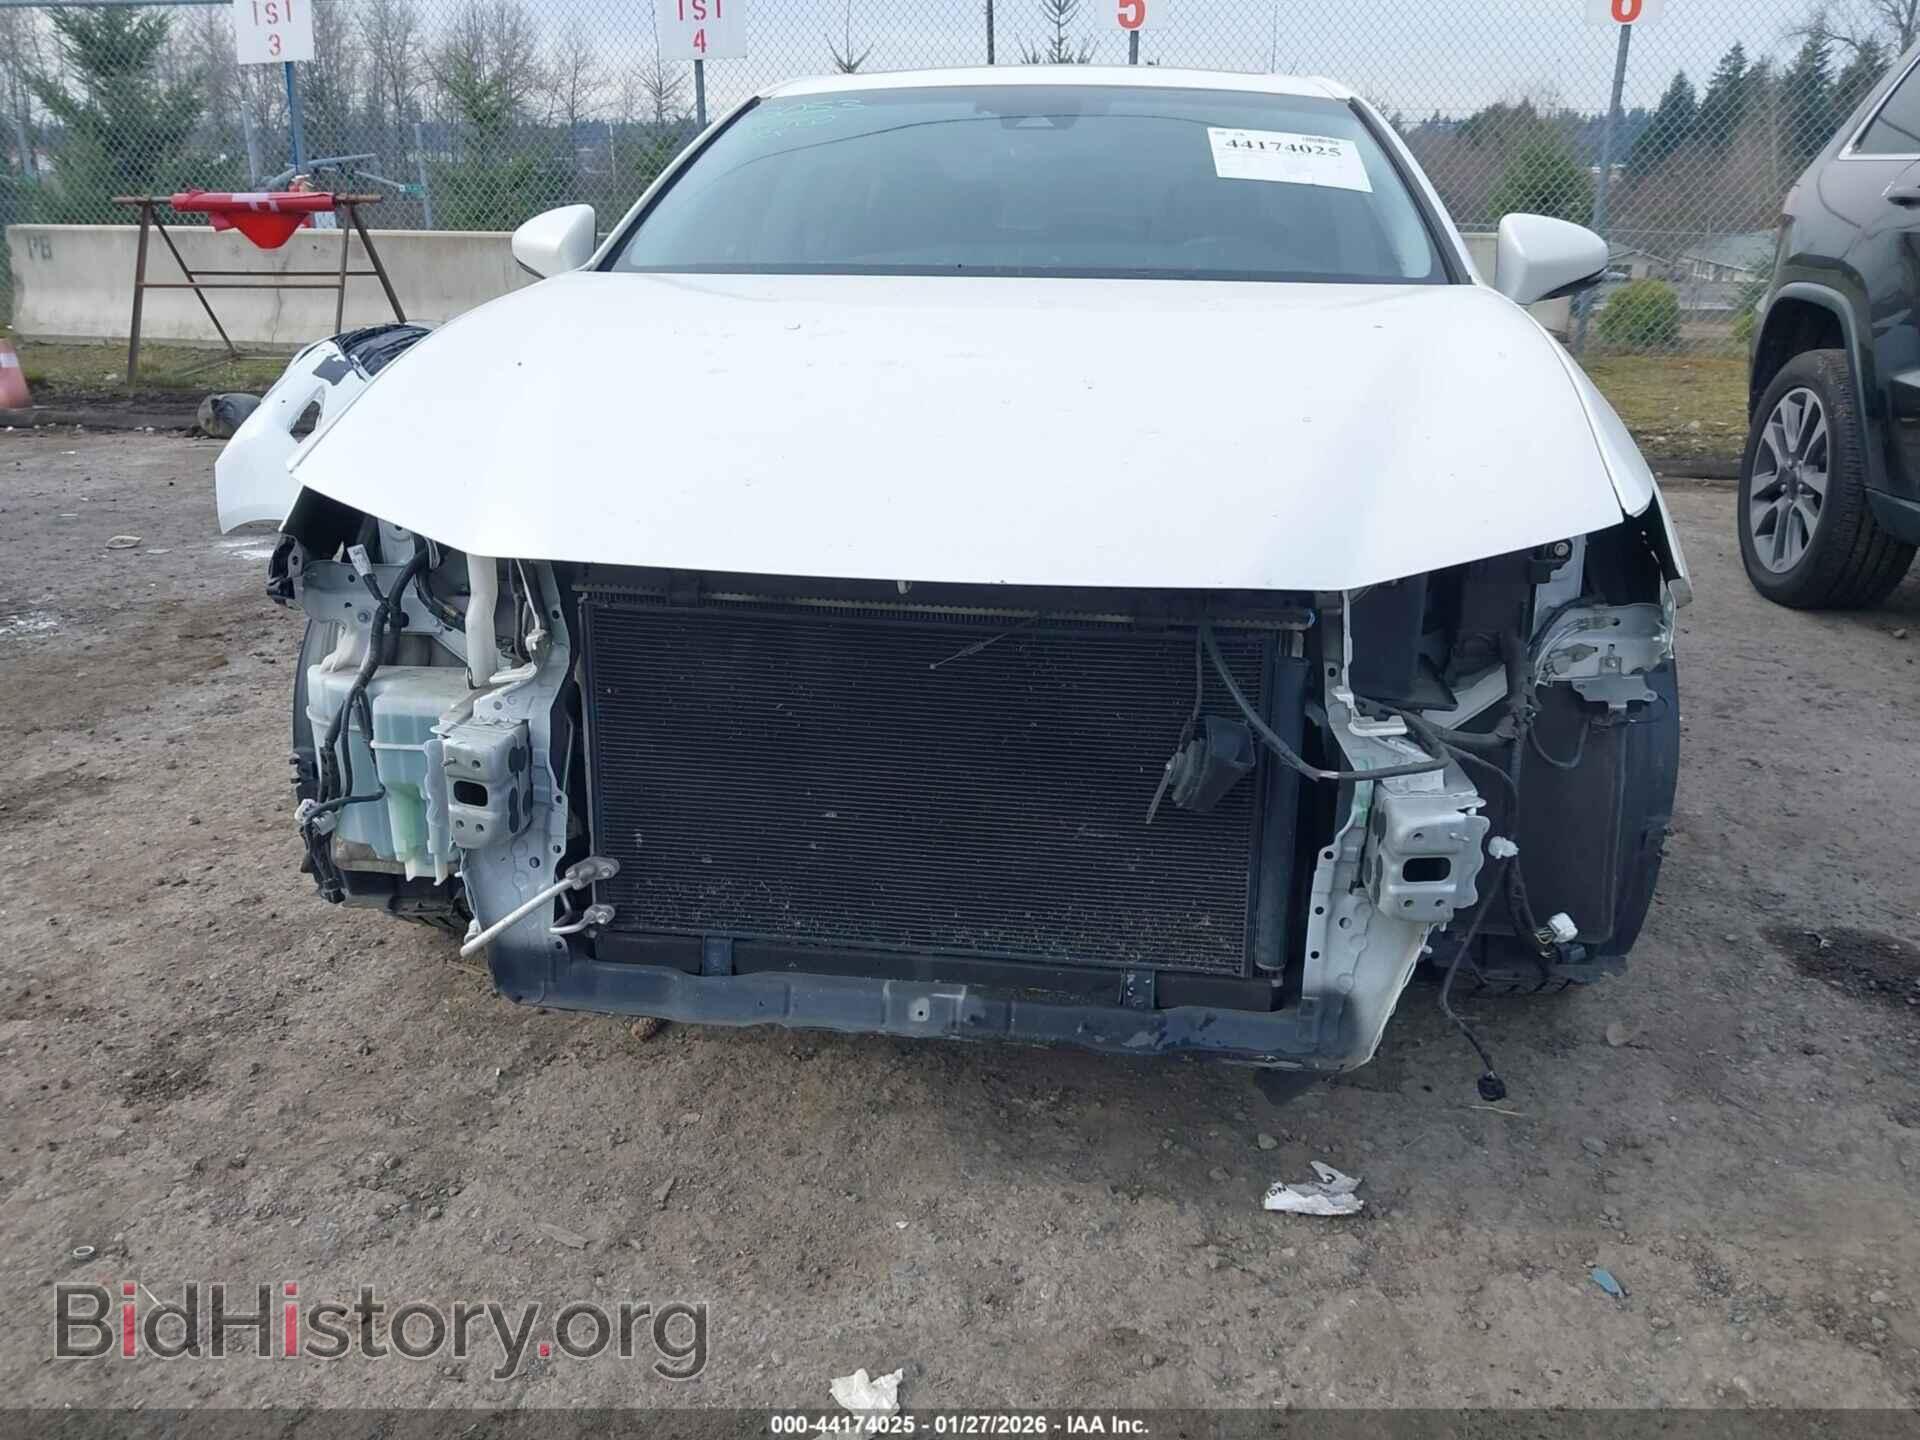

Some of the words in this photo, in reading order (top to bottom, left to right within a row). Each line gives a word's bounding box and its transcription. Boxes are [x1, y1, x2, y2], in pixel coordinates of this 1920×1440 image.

[1117, 0, 1146, 29] 5
[267, 33, 281, 57] 3
[692, 28, 706, 54] 4
[1225, 138, 1343, 158] 44174025
